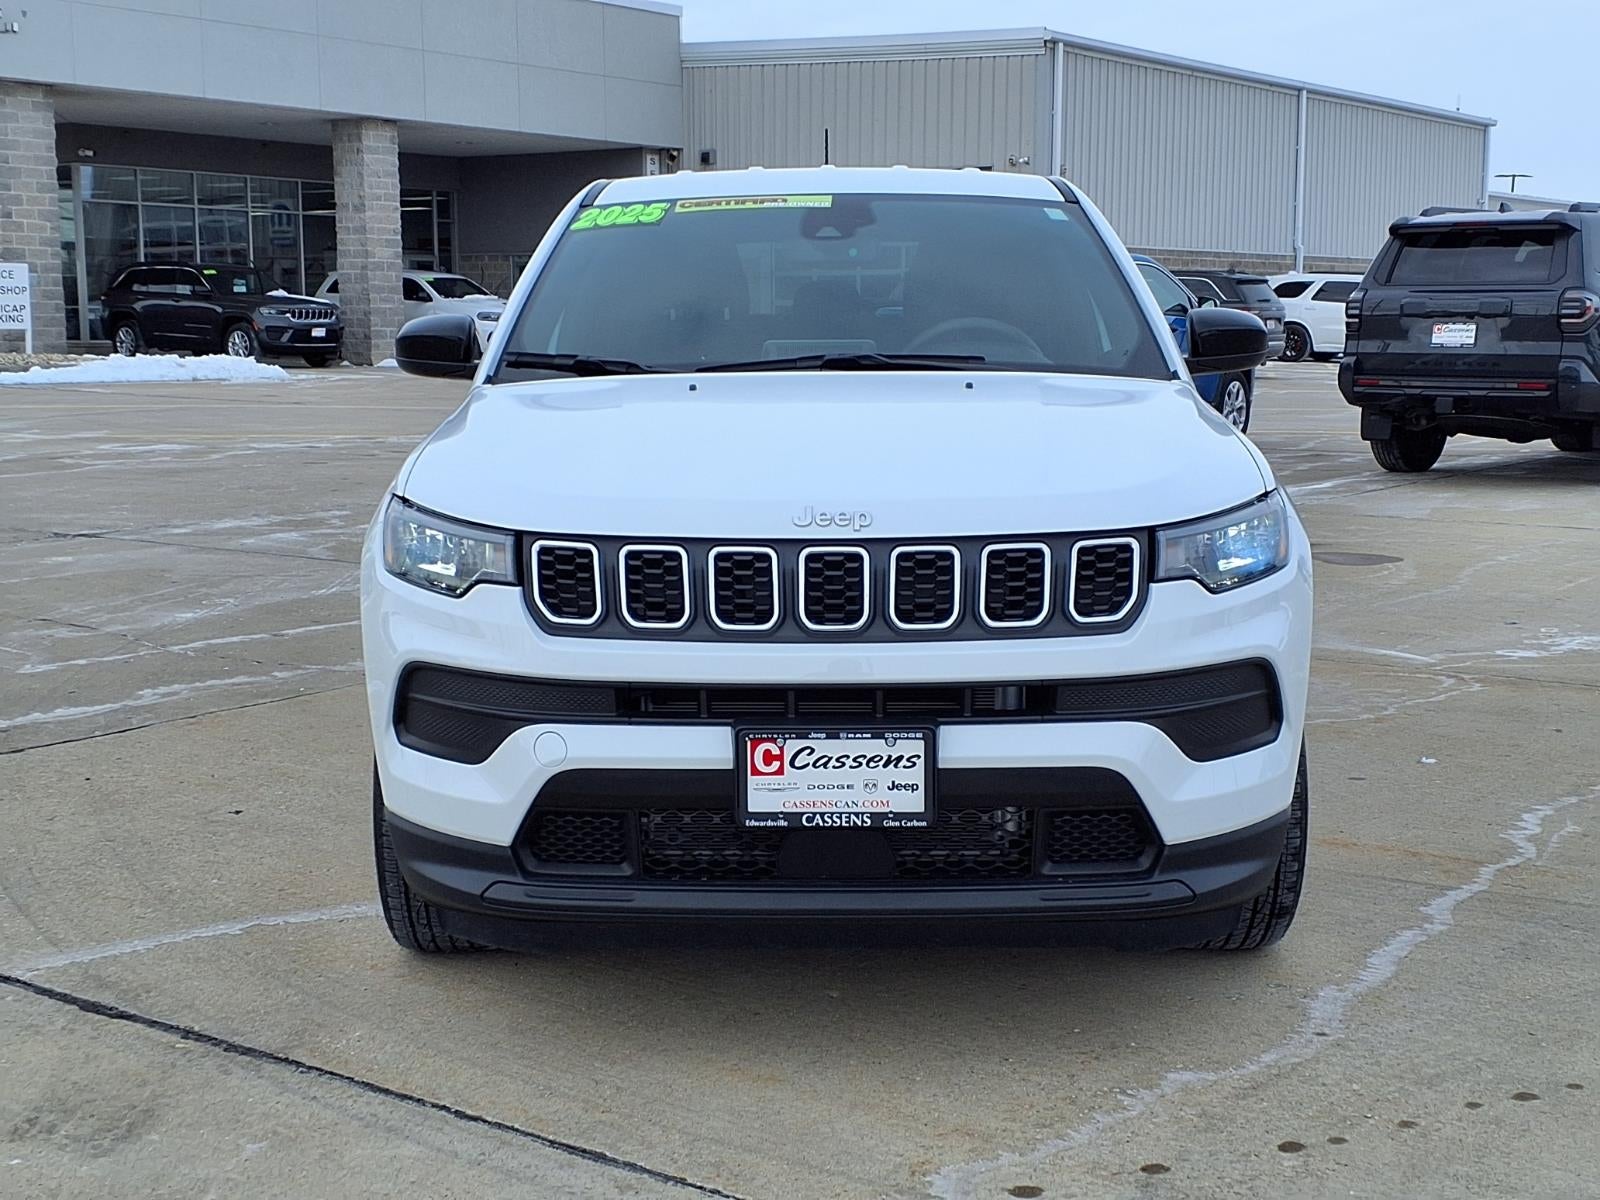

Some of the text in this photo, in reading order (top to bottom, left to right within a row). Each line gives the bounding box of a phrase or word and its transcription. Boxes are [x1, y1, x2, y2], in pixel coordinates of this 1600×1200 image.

[570, 202, 671, 231] 2025
[0, 285, 28, 295] SHOP
[792, 504, 873, 532] Jeep
[754, 742, 922, 773] C Cassens
[887, 780, 919, 794] Jeep
[782, 799, 890, 809] CASSENSCAN.COM
[745, 813, 927, 827] Edwardsville CASSENS Glen Carbon
